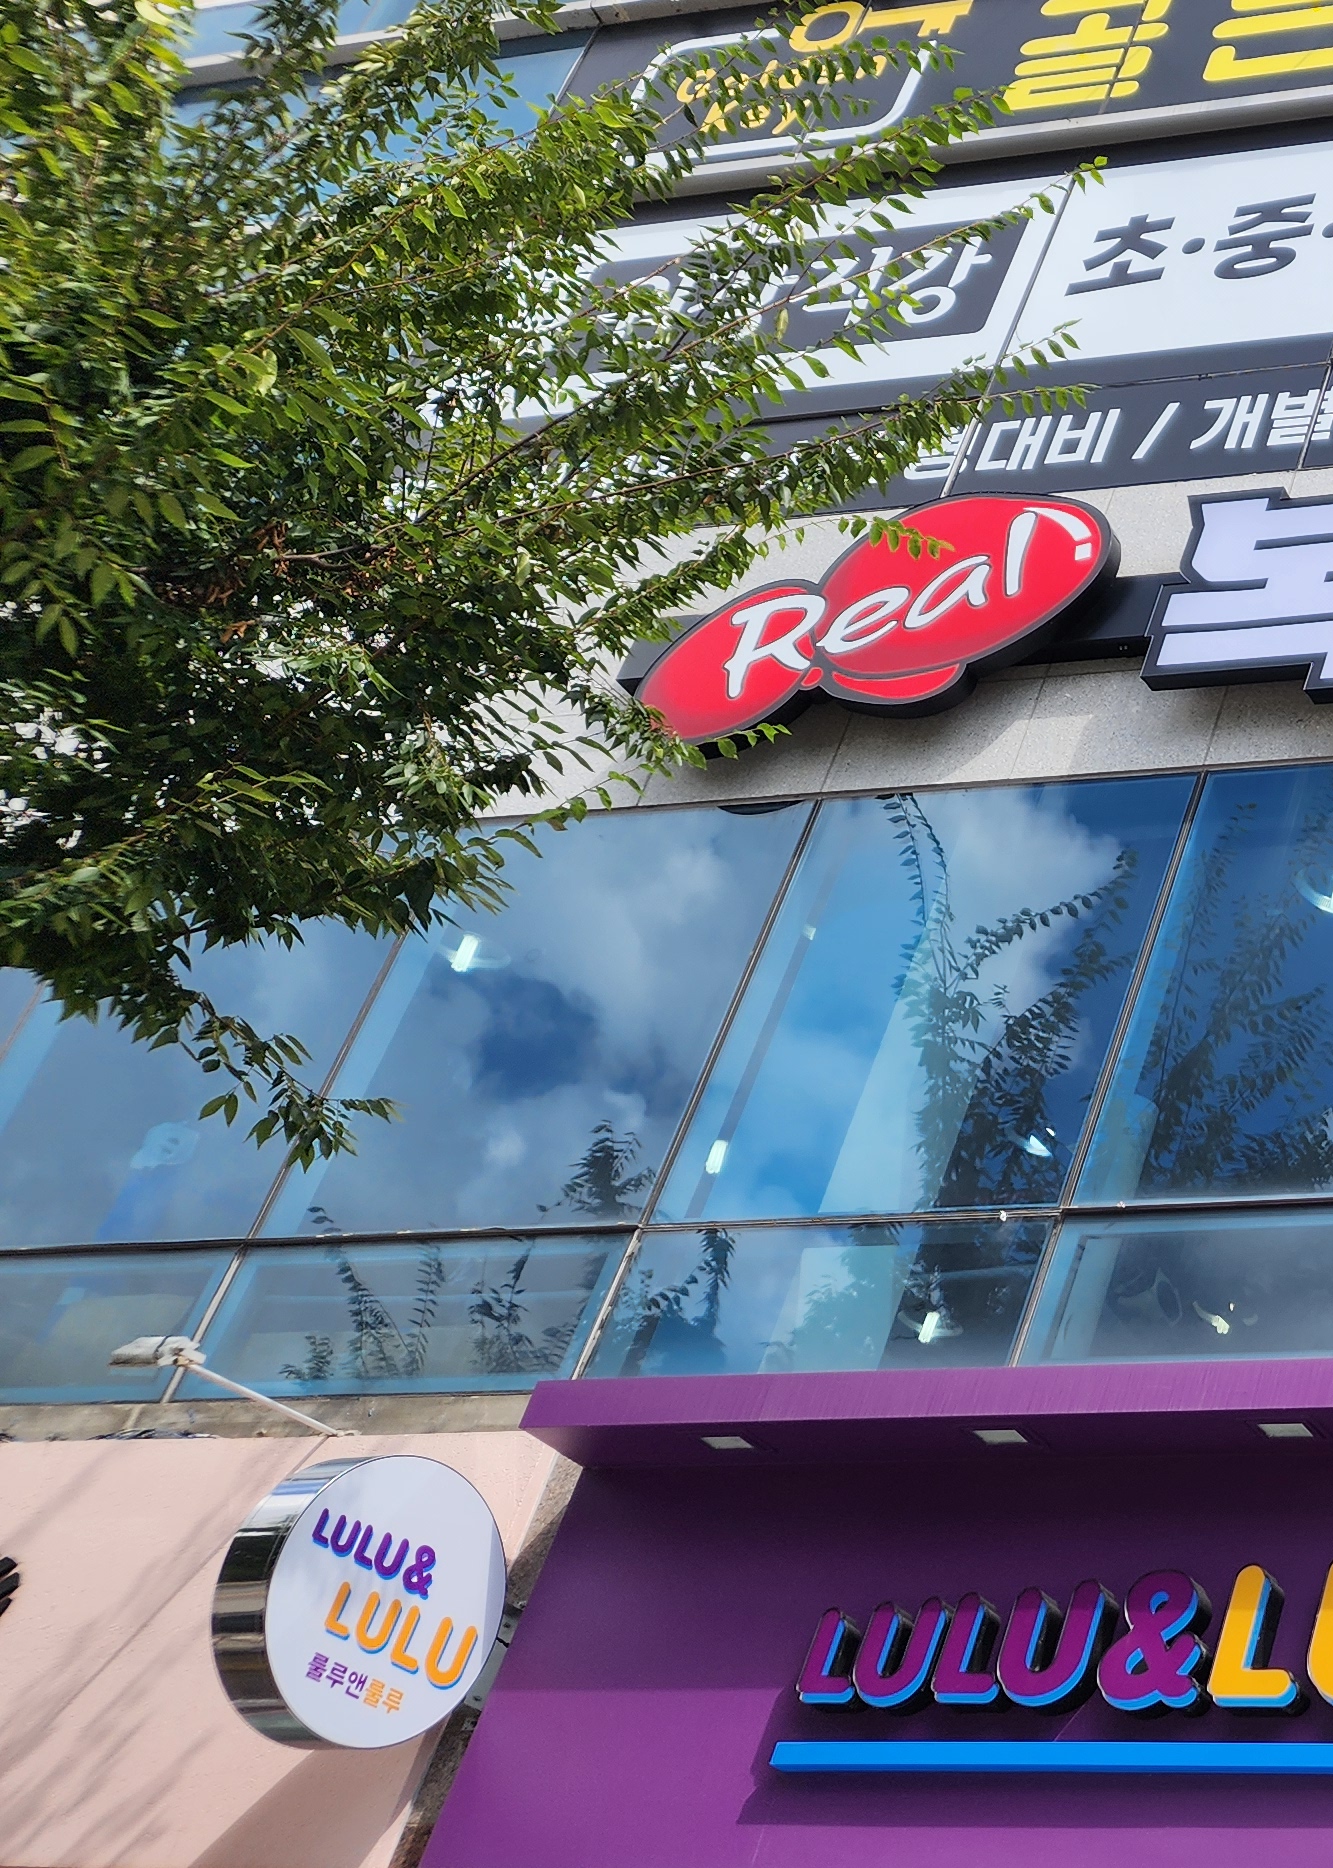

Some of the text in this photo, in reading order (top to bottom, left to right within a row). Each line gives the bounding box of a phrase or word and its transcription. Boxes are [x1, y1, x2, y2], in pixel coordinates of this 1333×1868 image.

[312, 1508, 436, 1600] LULU&
[324, 1581, 478, 1690] LULU
[305, 1652, 404, 1713] 룰루앤룰루
